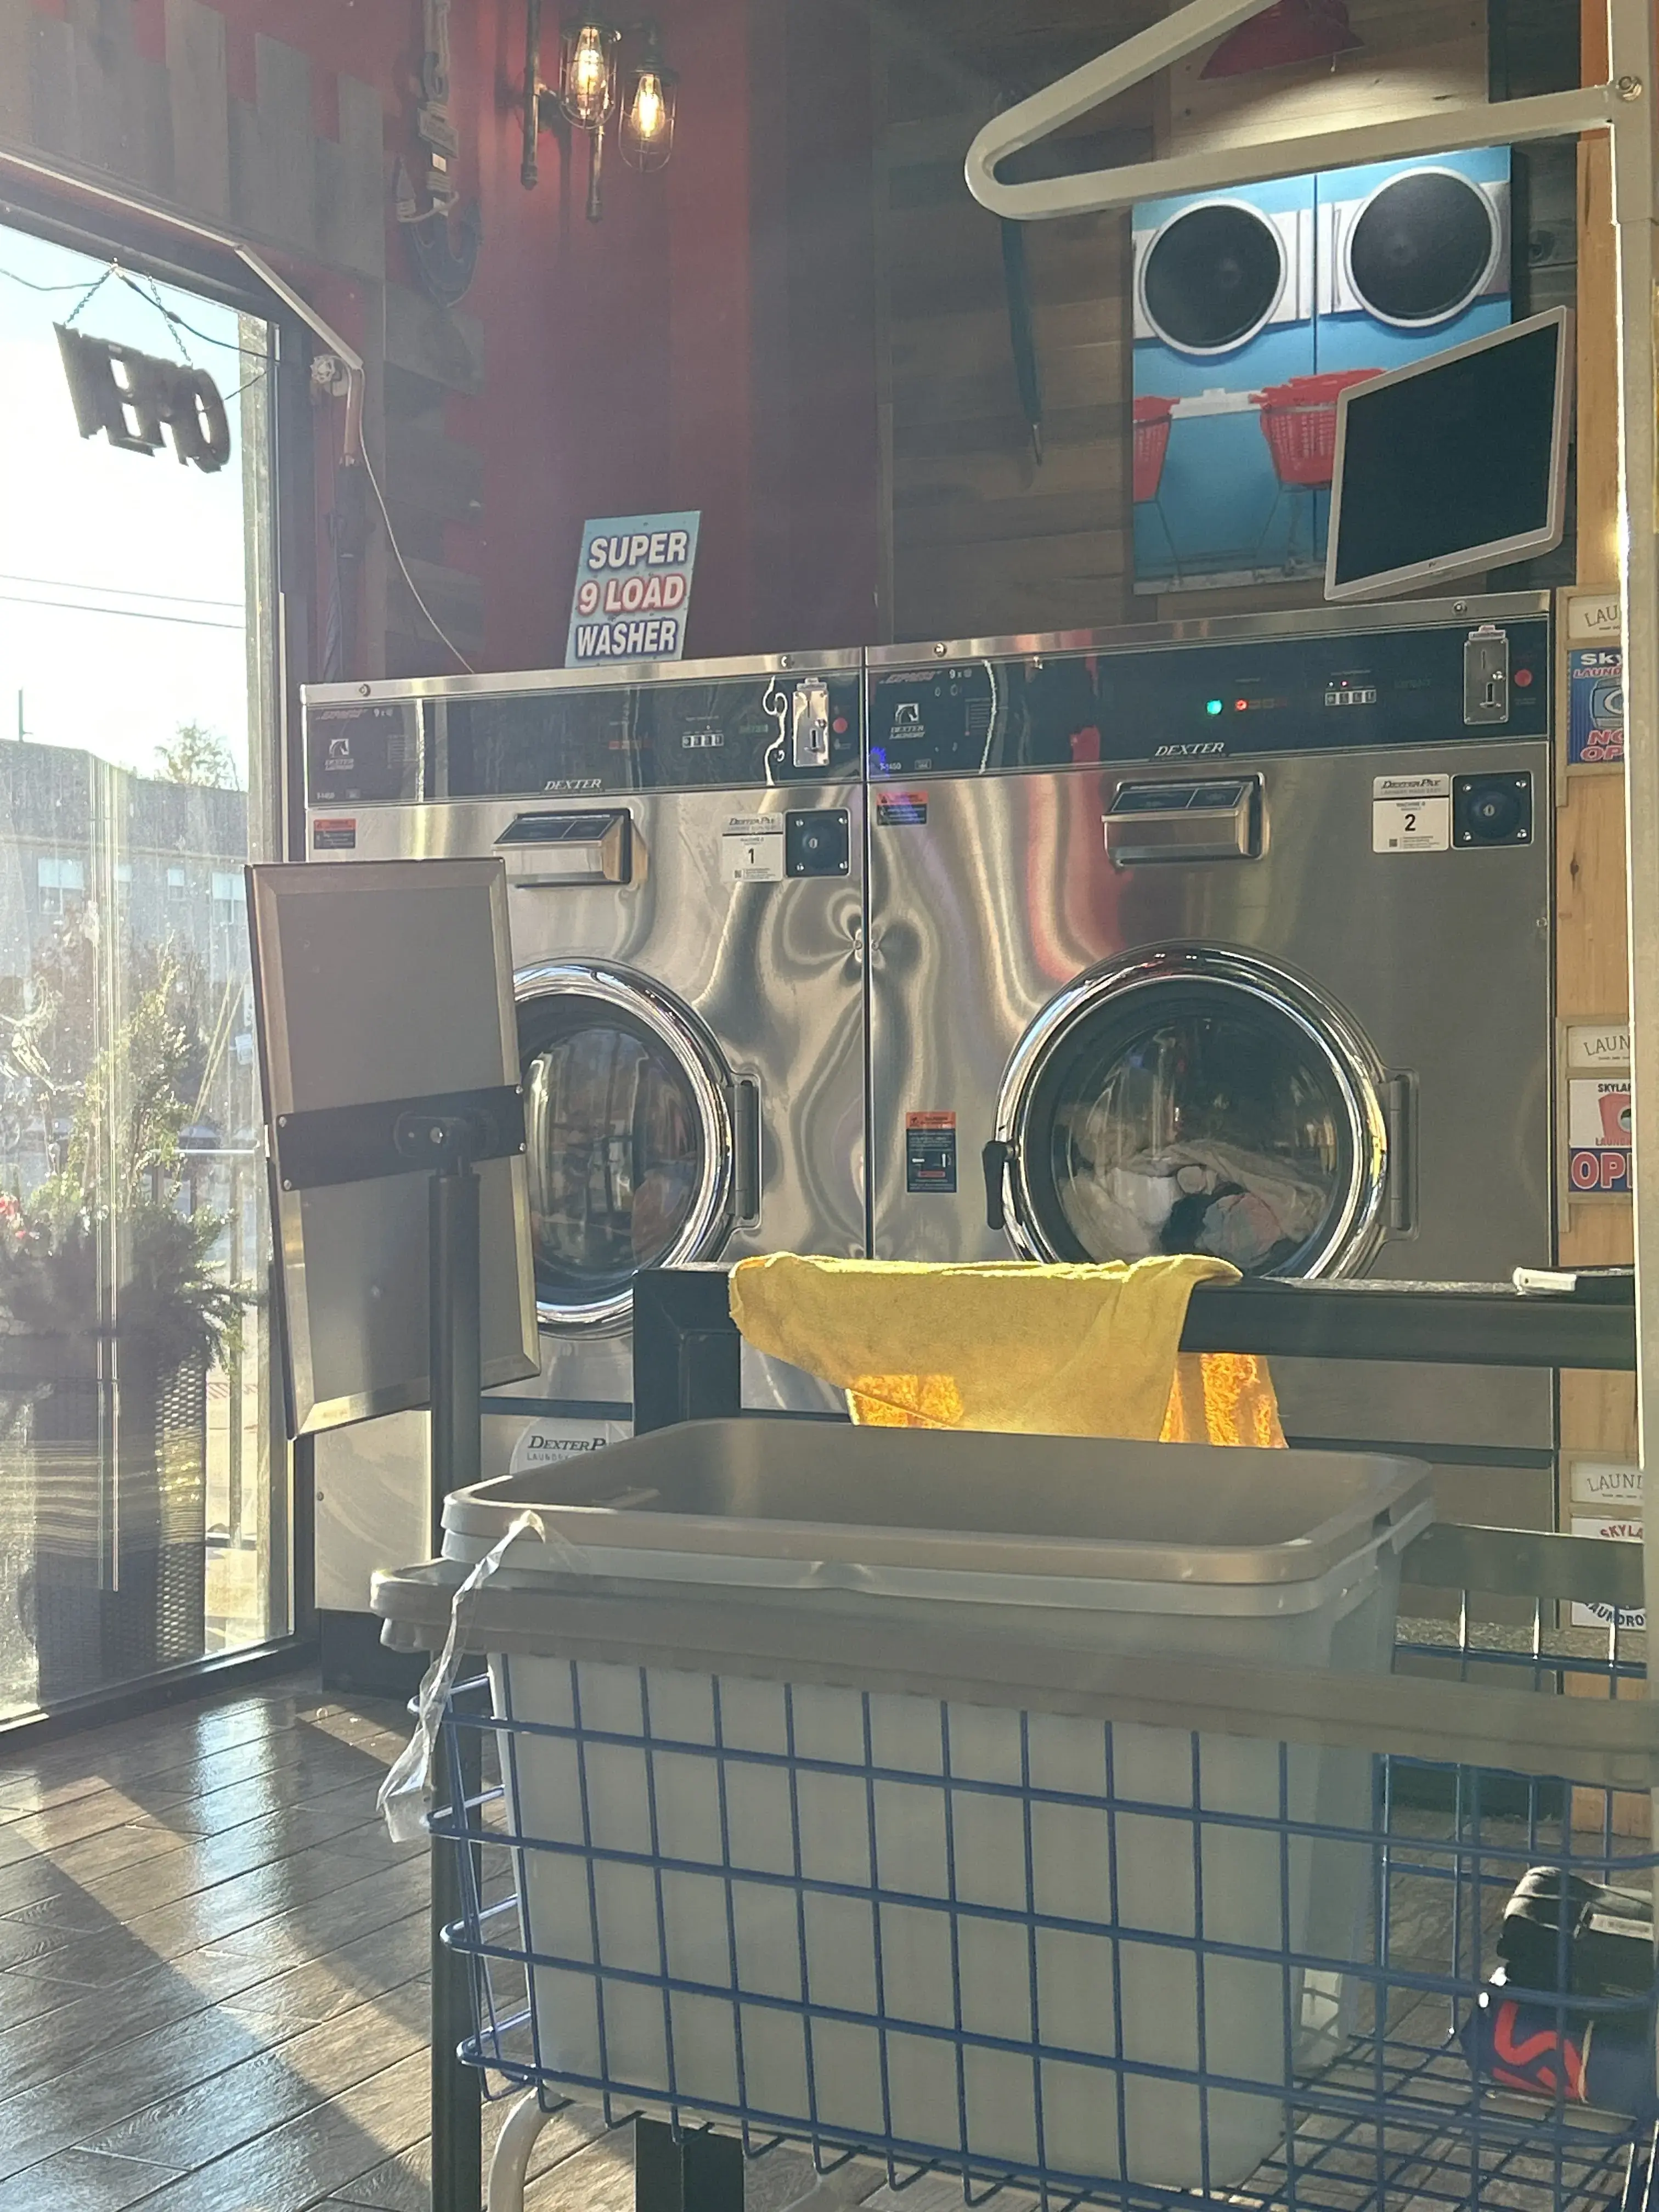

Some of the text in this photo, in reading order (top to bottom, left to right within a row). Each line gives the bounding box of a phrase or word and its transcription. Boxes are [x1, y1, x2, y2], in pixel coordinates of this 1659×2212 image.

[588, 531, 688, 570] SUPER
[578, 574, 686, 614] 9 LOAD
[1584, 605, 1618, 627] LAU
[577, 619, 678, 657] WASHER
[1154, 742, 1225, 757] DEXTER
[1580, 745, 1624, 762] OP
[544, 778, 602, 791] DEXTER
[1404, 814, 1416, 831] 2
[748, 848, 754, 864] 1
[1571, 1152, 1632, 1189] OP
[527, 1435, 606, 1451] DEXTERP
